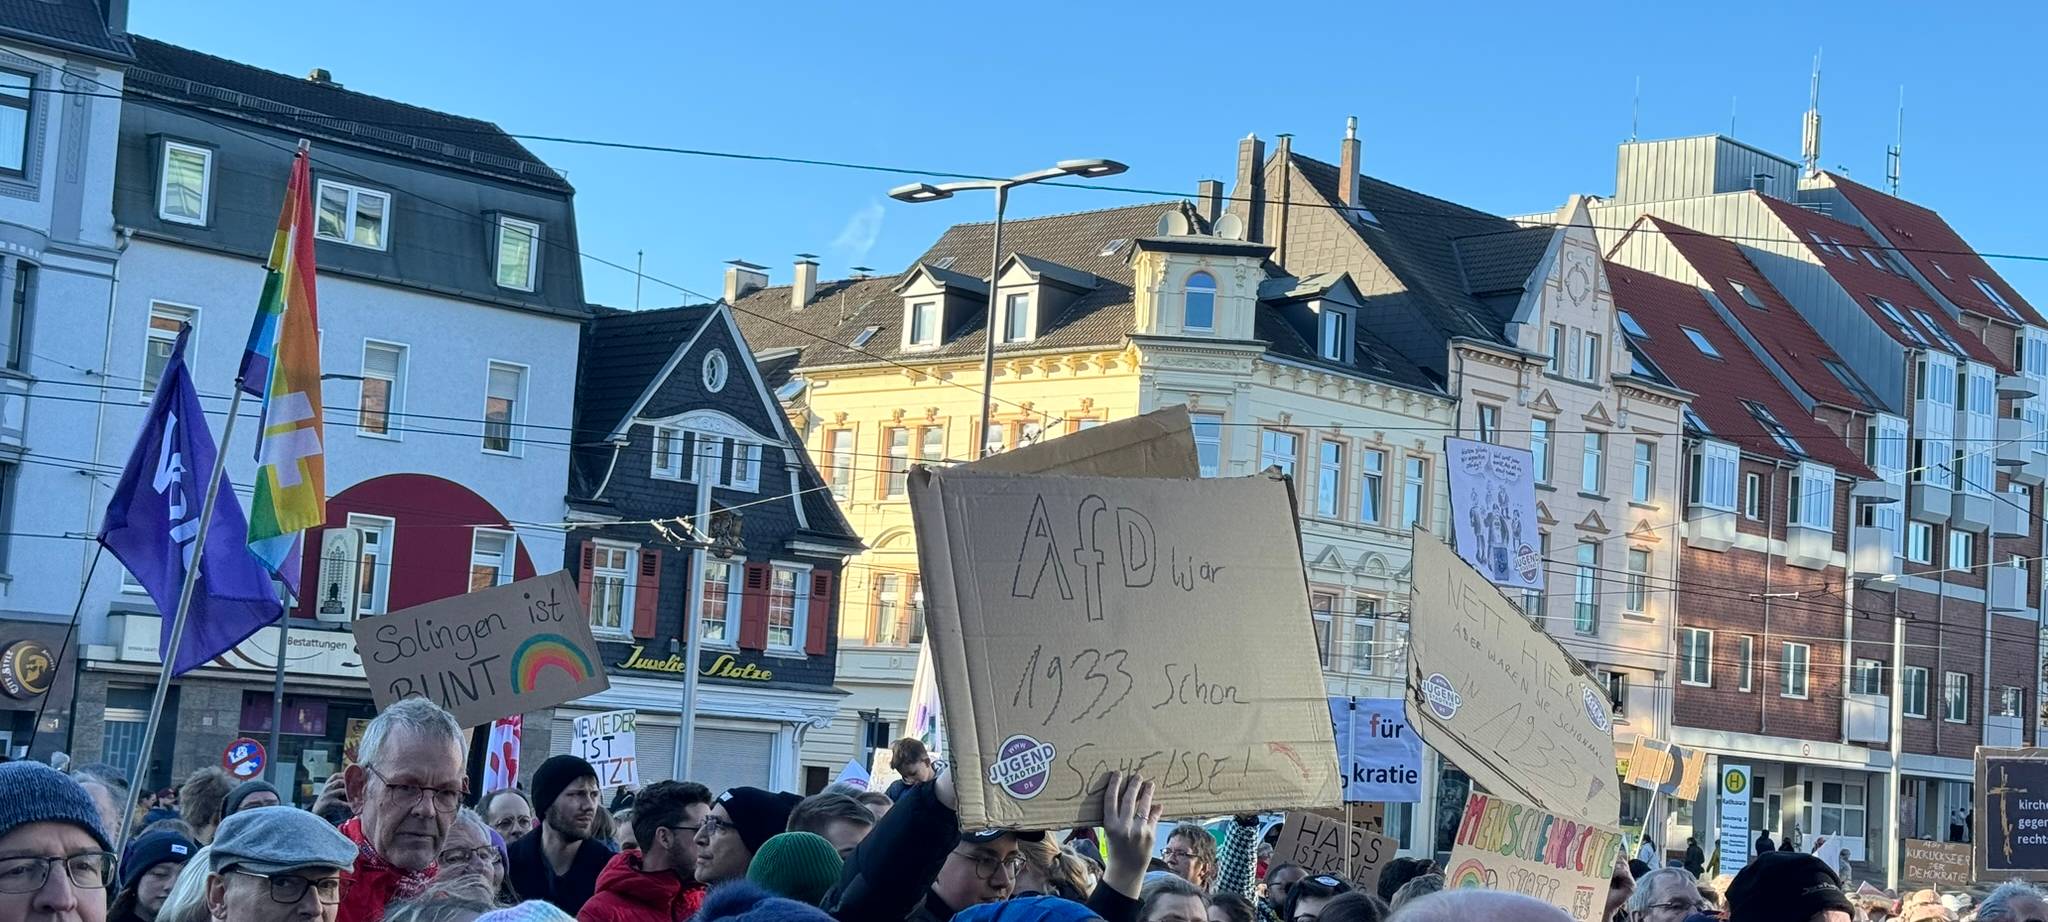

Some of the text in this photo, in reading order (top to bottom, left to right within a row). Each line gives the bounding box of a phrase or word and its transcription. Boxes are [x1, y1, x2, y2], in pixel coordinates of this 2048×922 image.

[1012, 493, 1227, 622] AfD war
[1446, 567, 1507, 641] NETT
[373, 588, 565, 664] Solingen ist
[287, 636, 348, 651] Bestattungen
[617, 645, 686, 673] Juwelie
[1013, 645, 1134, 727] 1933
[1487, 648, 1529, 694] WAREN
[1422, 679, 1461, 706] JUGEND
[1369, 713, 1404, 739] für
[582, 736, 615, 760] IST
[1472, 702, 1578, 790] 1933
[591, 757, 635, 787] TZT
[991, 746, 1055, 781] JUGEND
[1004, 762, 1047, 785] STADTRAT
[1297, 816, 1382, 864] HASS
[1457, 793, 1622, 878] MENSCHENRECHTE
[1294, 843, 1323, 868] IST
[1909, 865, 1968, 882] DEMOKRATIE
